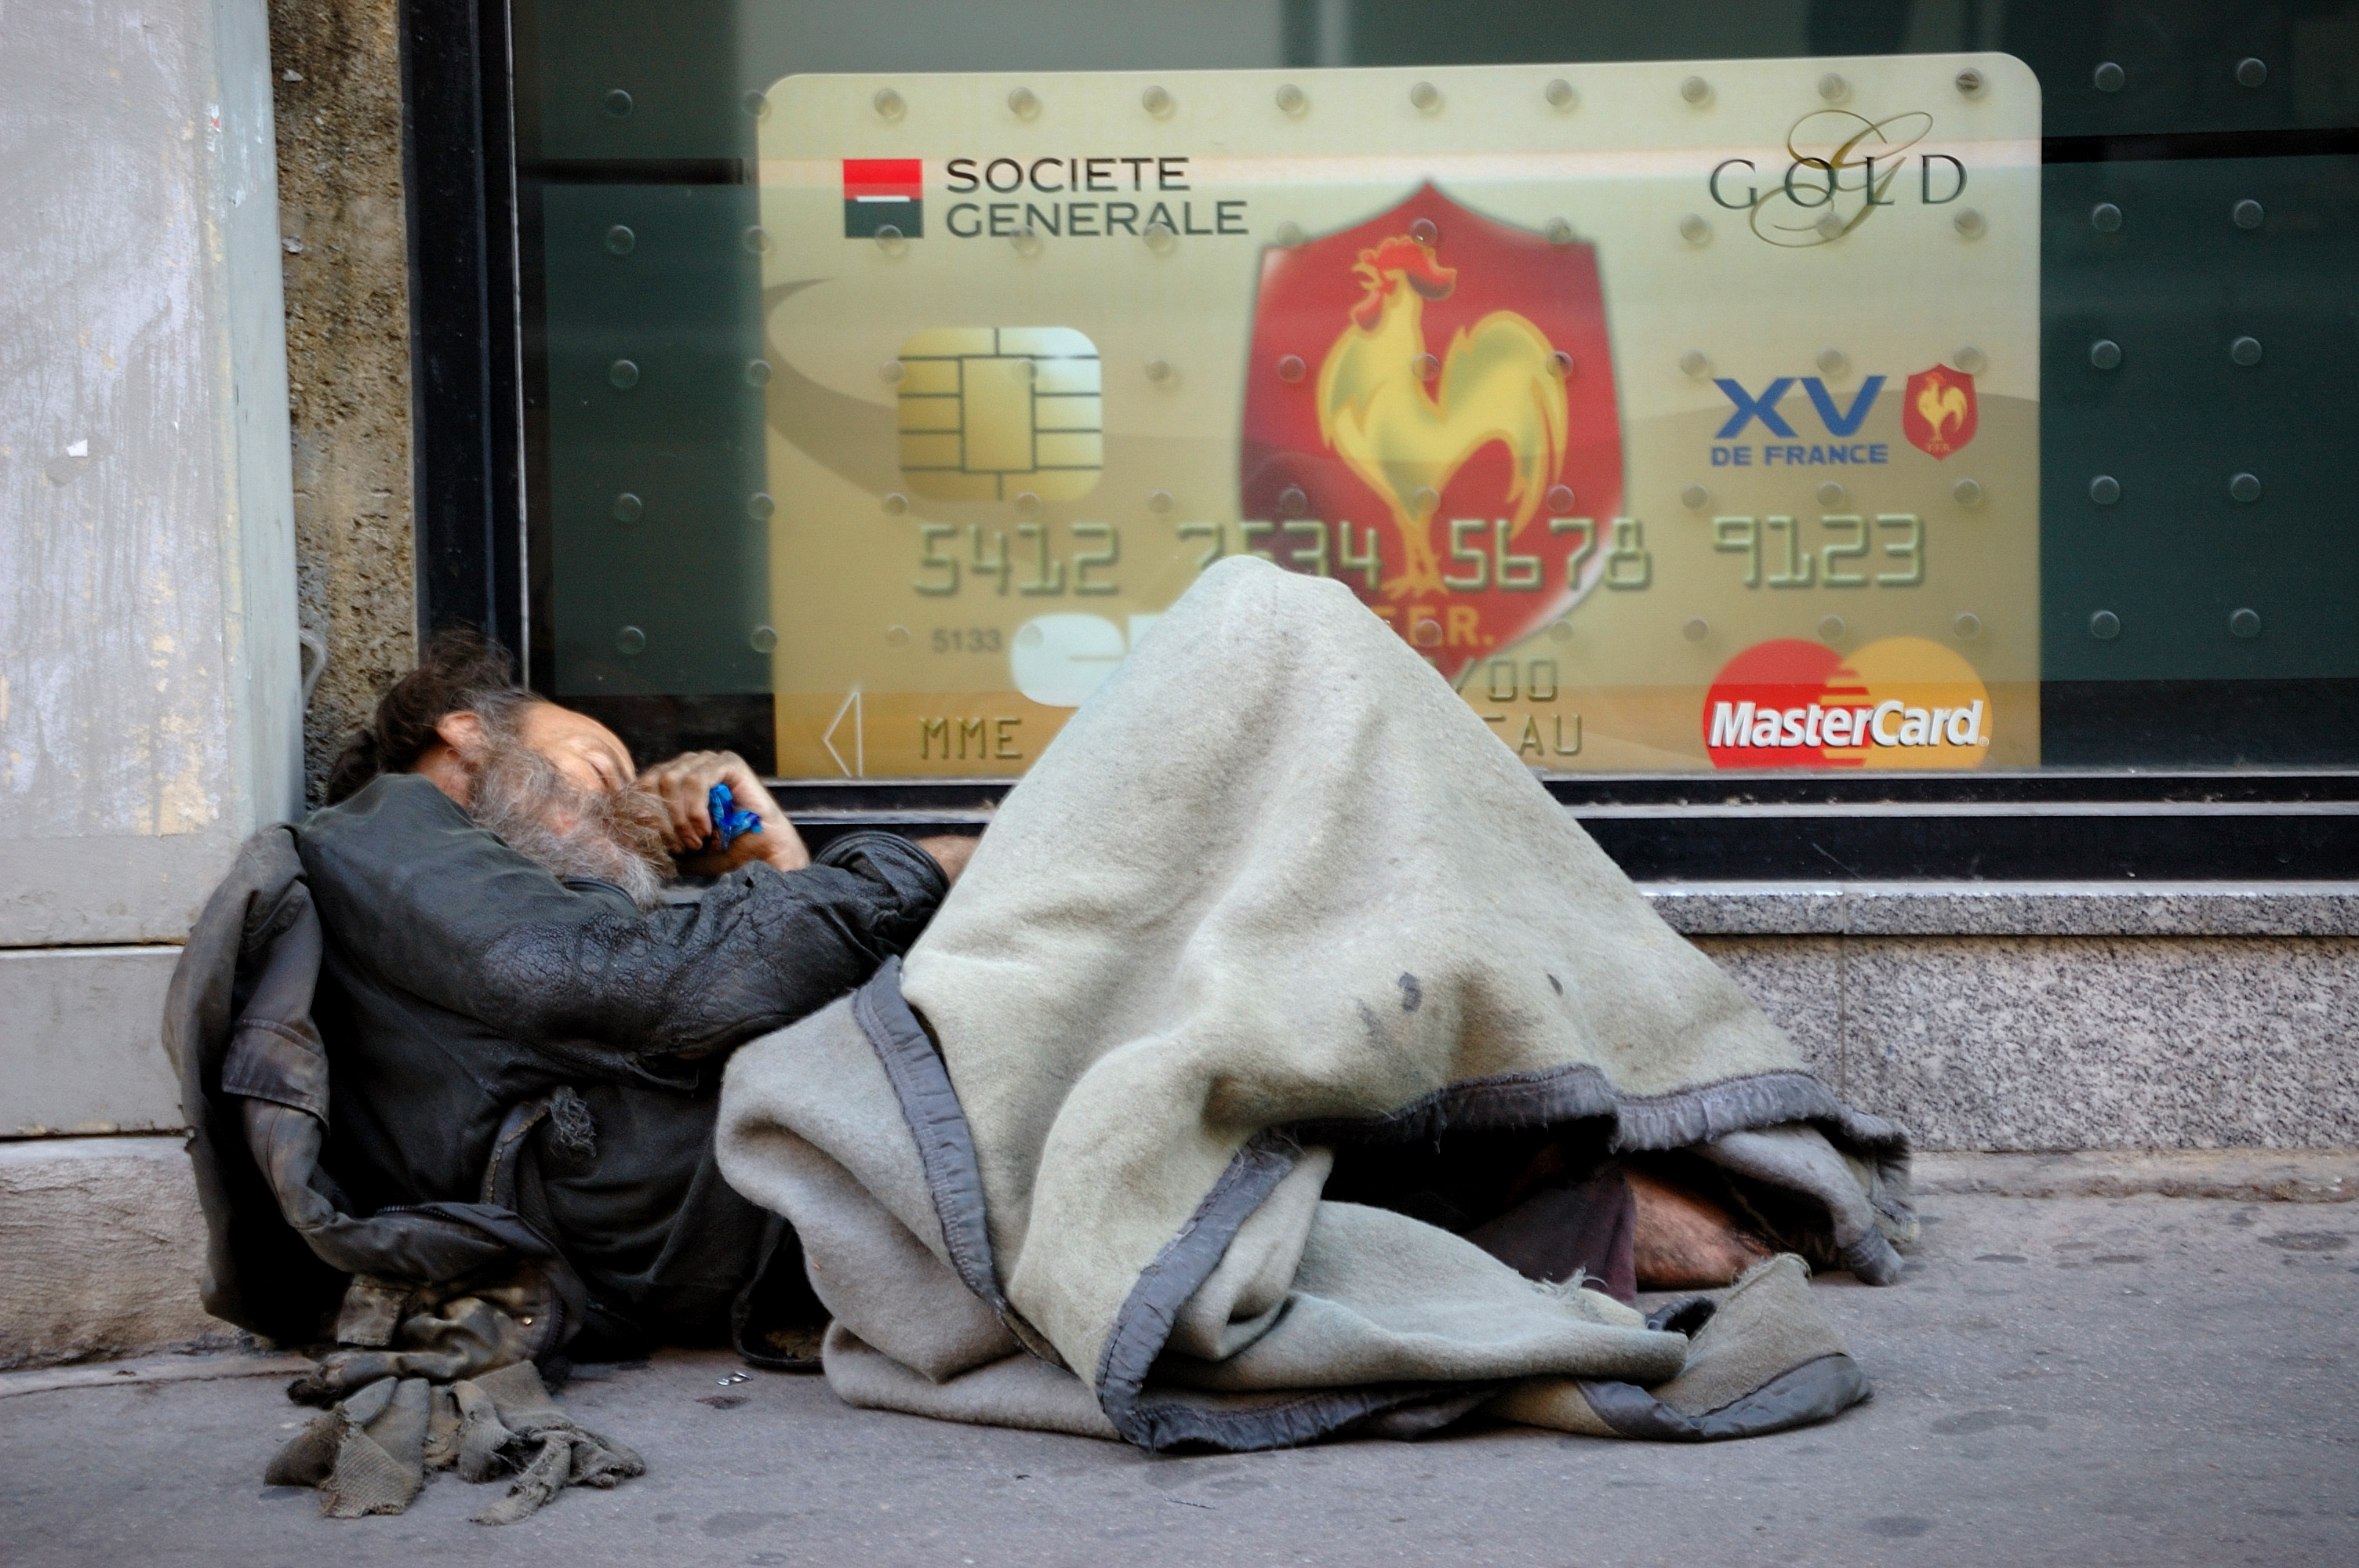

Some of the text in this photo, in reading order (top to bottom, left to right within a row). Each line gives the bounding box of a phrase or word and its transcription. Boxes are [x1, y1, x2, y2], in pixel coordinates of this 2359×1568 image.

[947, 156, 1190, 194] SOCIETE
[1709, 154, 1968, 210] GOLD
[946, 200, 1249, 238] GENERALE
[1712, 375, 1888, 439] XV
[1711, 444, 1888, 467] DE FRANCE
[912, 522, 1121, 597] 5412
[1443, 517, 1653, 593] 5678
[1712, 513, 1927, 589] 9123
[931, 627, 1003, 655] 5133
[919, 717, 1023, 760] MME
[1709, 699, 1984, 748] MasterCard
